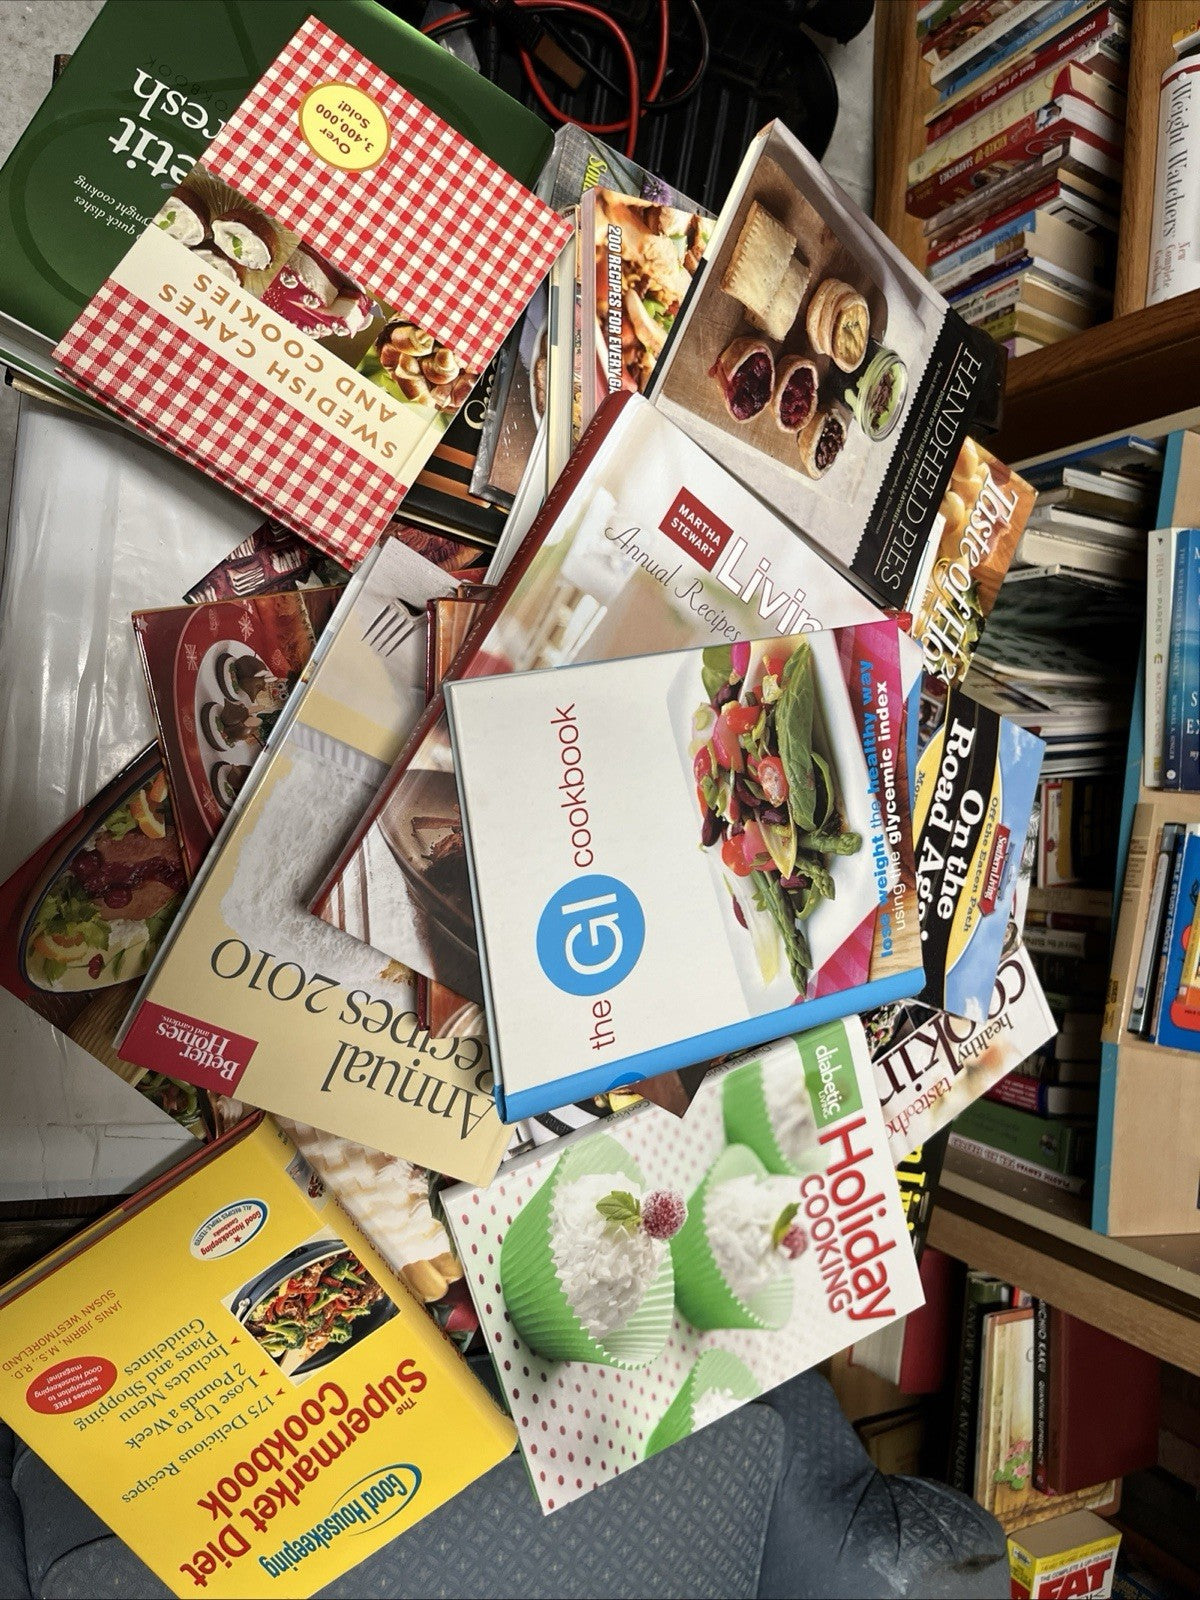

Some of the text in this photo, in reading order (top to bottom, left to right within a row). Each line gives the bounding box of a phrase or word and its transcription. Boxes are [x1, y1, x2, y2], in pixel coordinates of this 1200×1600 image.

[115, 64, 226, 158] resh
[314, 102, 375, 153] 3,400,000
[337, 100, 371, 129] Sold!
[1166, 81, 1192, 145] Weight
[318, 125, 352, 155] Over
[71, 193, 106, 220] dishes
[72, 173, 117, 207] cooking
[103, 212, 136, 236] quick
[608, 225, 621, 251] 200
[608, 254, 621, 306] RECIPES
[190, 271, 327, 375] COOKIES
[608, 309, 621, 333] FOR
[156, 281, 399, 460] SWEDISH CAKES
[608, 337, 621, 375] EVERY
[332, 374, 398, 426] AND
[927, 416, 935, 426] OF
[930, 389, 945, 417] DOZENS
[901, 347, 985, 525] HANDHELD
[904, 458, 920, 486] SWEETS
[677, 503, 723, 547] MARTHA
[890, 489, 908, 523] SAVORIES
[953, 473, 1023, 571] Taste
[669, 516, 715, 559] STEWART
[877, 519, 920, 590] PIES
[605, 528, 741, 642] Annual Recipes
[714, 536, 824, 637] Livin
[927, 557, 988, 620] of
[1154, 597, 1162, 644] PARENTS
[927, 718, 977, 831] Road
[859, 659, 892, 957] lose weight the healthy way
[875, 680, 905, 931] using the glycemic index
[549, 703, 620, 1051] the GI cookbook
[933, 787, 987, 921] On the
[961, 796, 1001, 933] Off the Eaten Path
[982, 834, 1007, 901] Southern Living
[1168, 883, 1178, 916] STUDY
[204, 932, 340, 1019] 2010
[154, 1012, 230, 1062] Homes
[194, 1026, 209, 1038] and
[728, 1044, 771, 1067] Diabetic
[950, 1012, 1015, 1067] healthy
[177, 1042, 239, 1081] Better
[813, 1041, 846, 1115] diabetic
[319, 1040, 495, 1146] Annual
[199, 1209, 262, 1256] Good Housekeeping
[220, 1206, 242, 1219] RECIPES
[817, 1116, 896, 1321] Holiday
[798, 1172, 855, 1314] COOKING
[0, 1288, 116, 1373] SUSAN WESTMORELAND
[57, 1320, 94, 1348] JIBRIN,
[93, 1299, 123, 1323] JANIS
[10, 1363, 33, 1382] R.D.
[122, 1315, 206, 1379] Guidelines
[1037, 1342, 1046, 1372] KAKU
[31, 1364, 103, 1400] Good Housekeeping
[45, 1363, 84, 1385] magazine!
[46, 1374, 99, 1403] subscription to
[51, 1382, 102, 1410] Includes FREE
[72, 1329, 218, 1434] Plans and Shopping
[118, 1342, 229, 1426] Includes Menu
[124, 1361, 247, 1453] 2 Pounds a Week
[175, 1374, 259, 1436] Lose Up to
[394, 1395, 417, 1417] The
[120, 1392, 276, 1505] 175 Delicious Recipes
[177, 1355, 431, 1593] Supermarket Diet
[196, 1377, 355, 1528] Cookbook
[257, 1471, 409, 1585] Good Housekeeping
[1037, 1556, 1112, 1600] FAT
